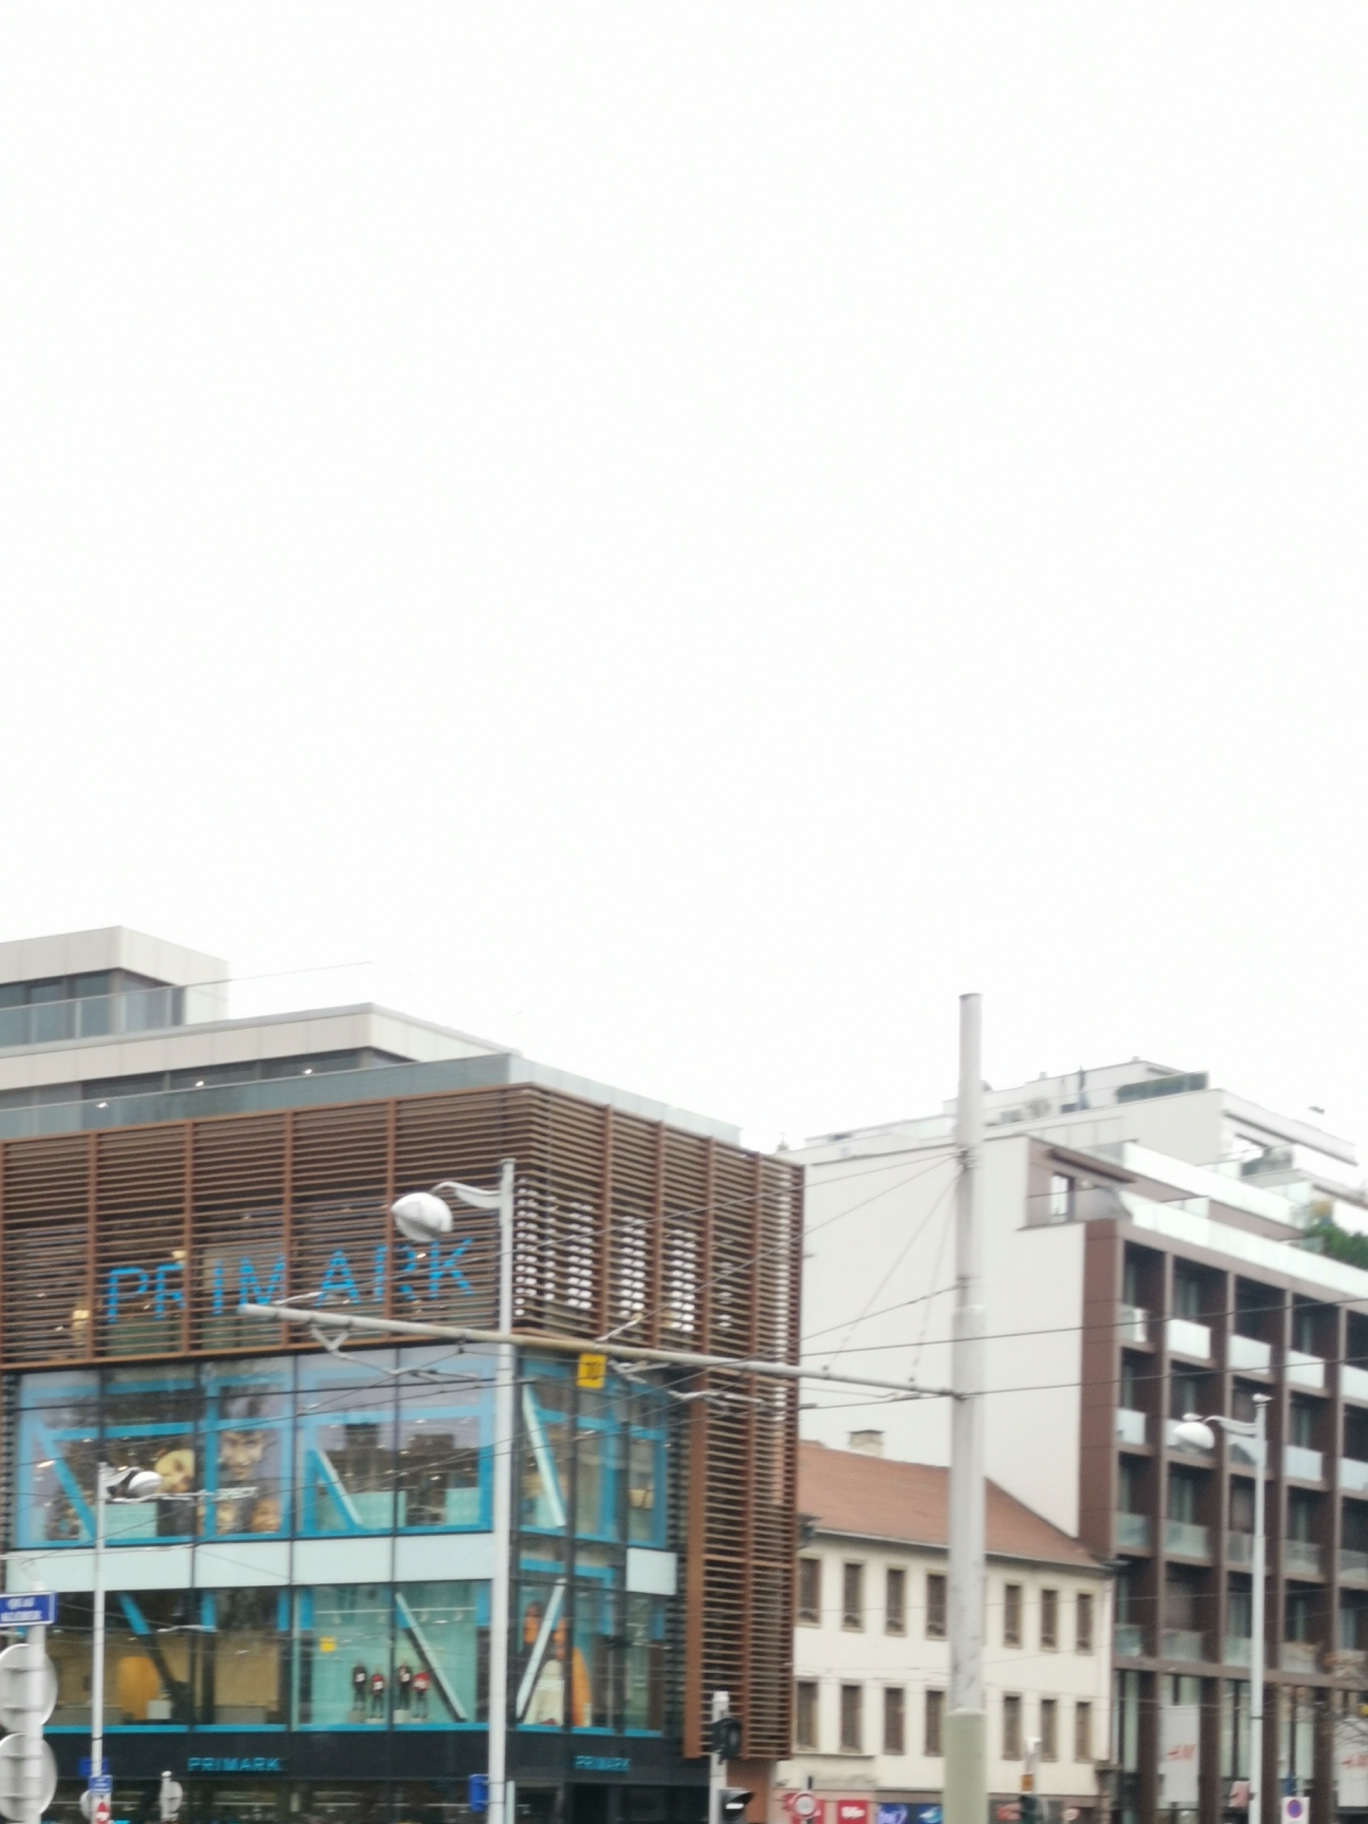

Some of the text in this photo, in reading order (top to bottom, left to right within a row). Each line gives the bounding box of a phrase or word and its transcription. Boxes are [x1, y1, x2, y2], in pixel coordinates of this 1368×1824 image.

[98, 1237, 474, 1323] PRIMARK
[187, 1757, 283, 1771] PRIMARK
[574, 1755, 630, 1772] PRIMARK
